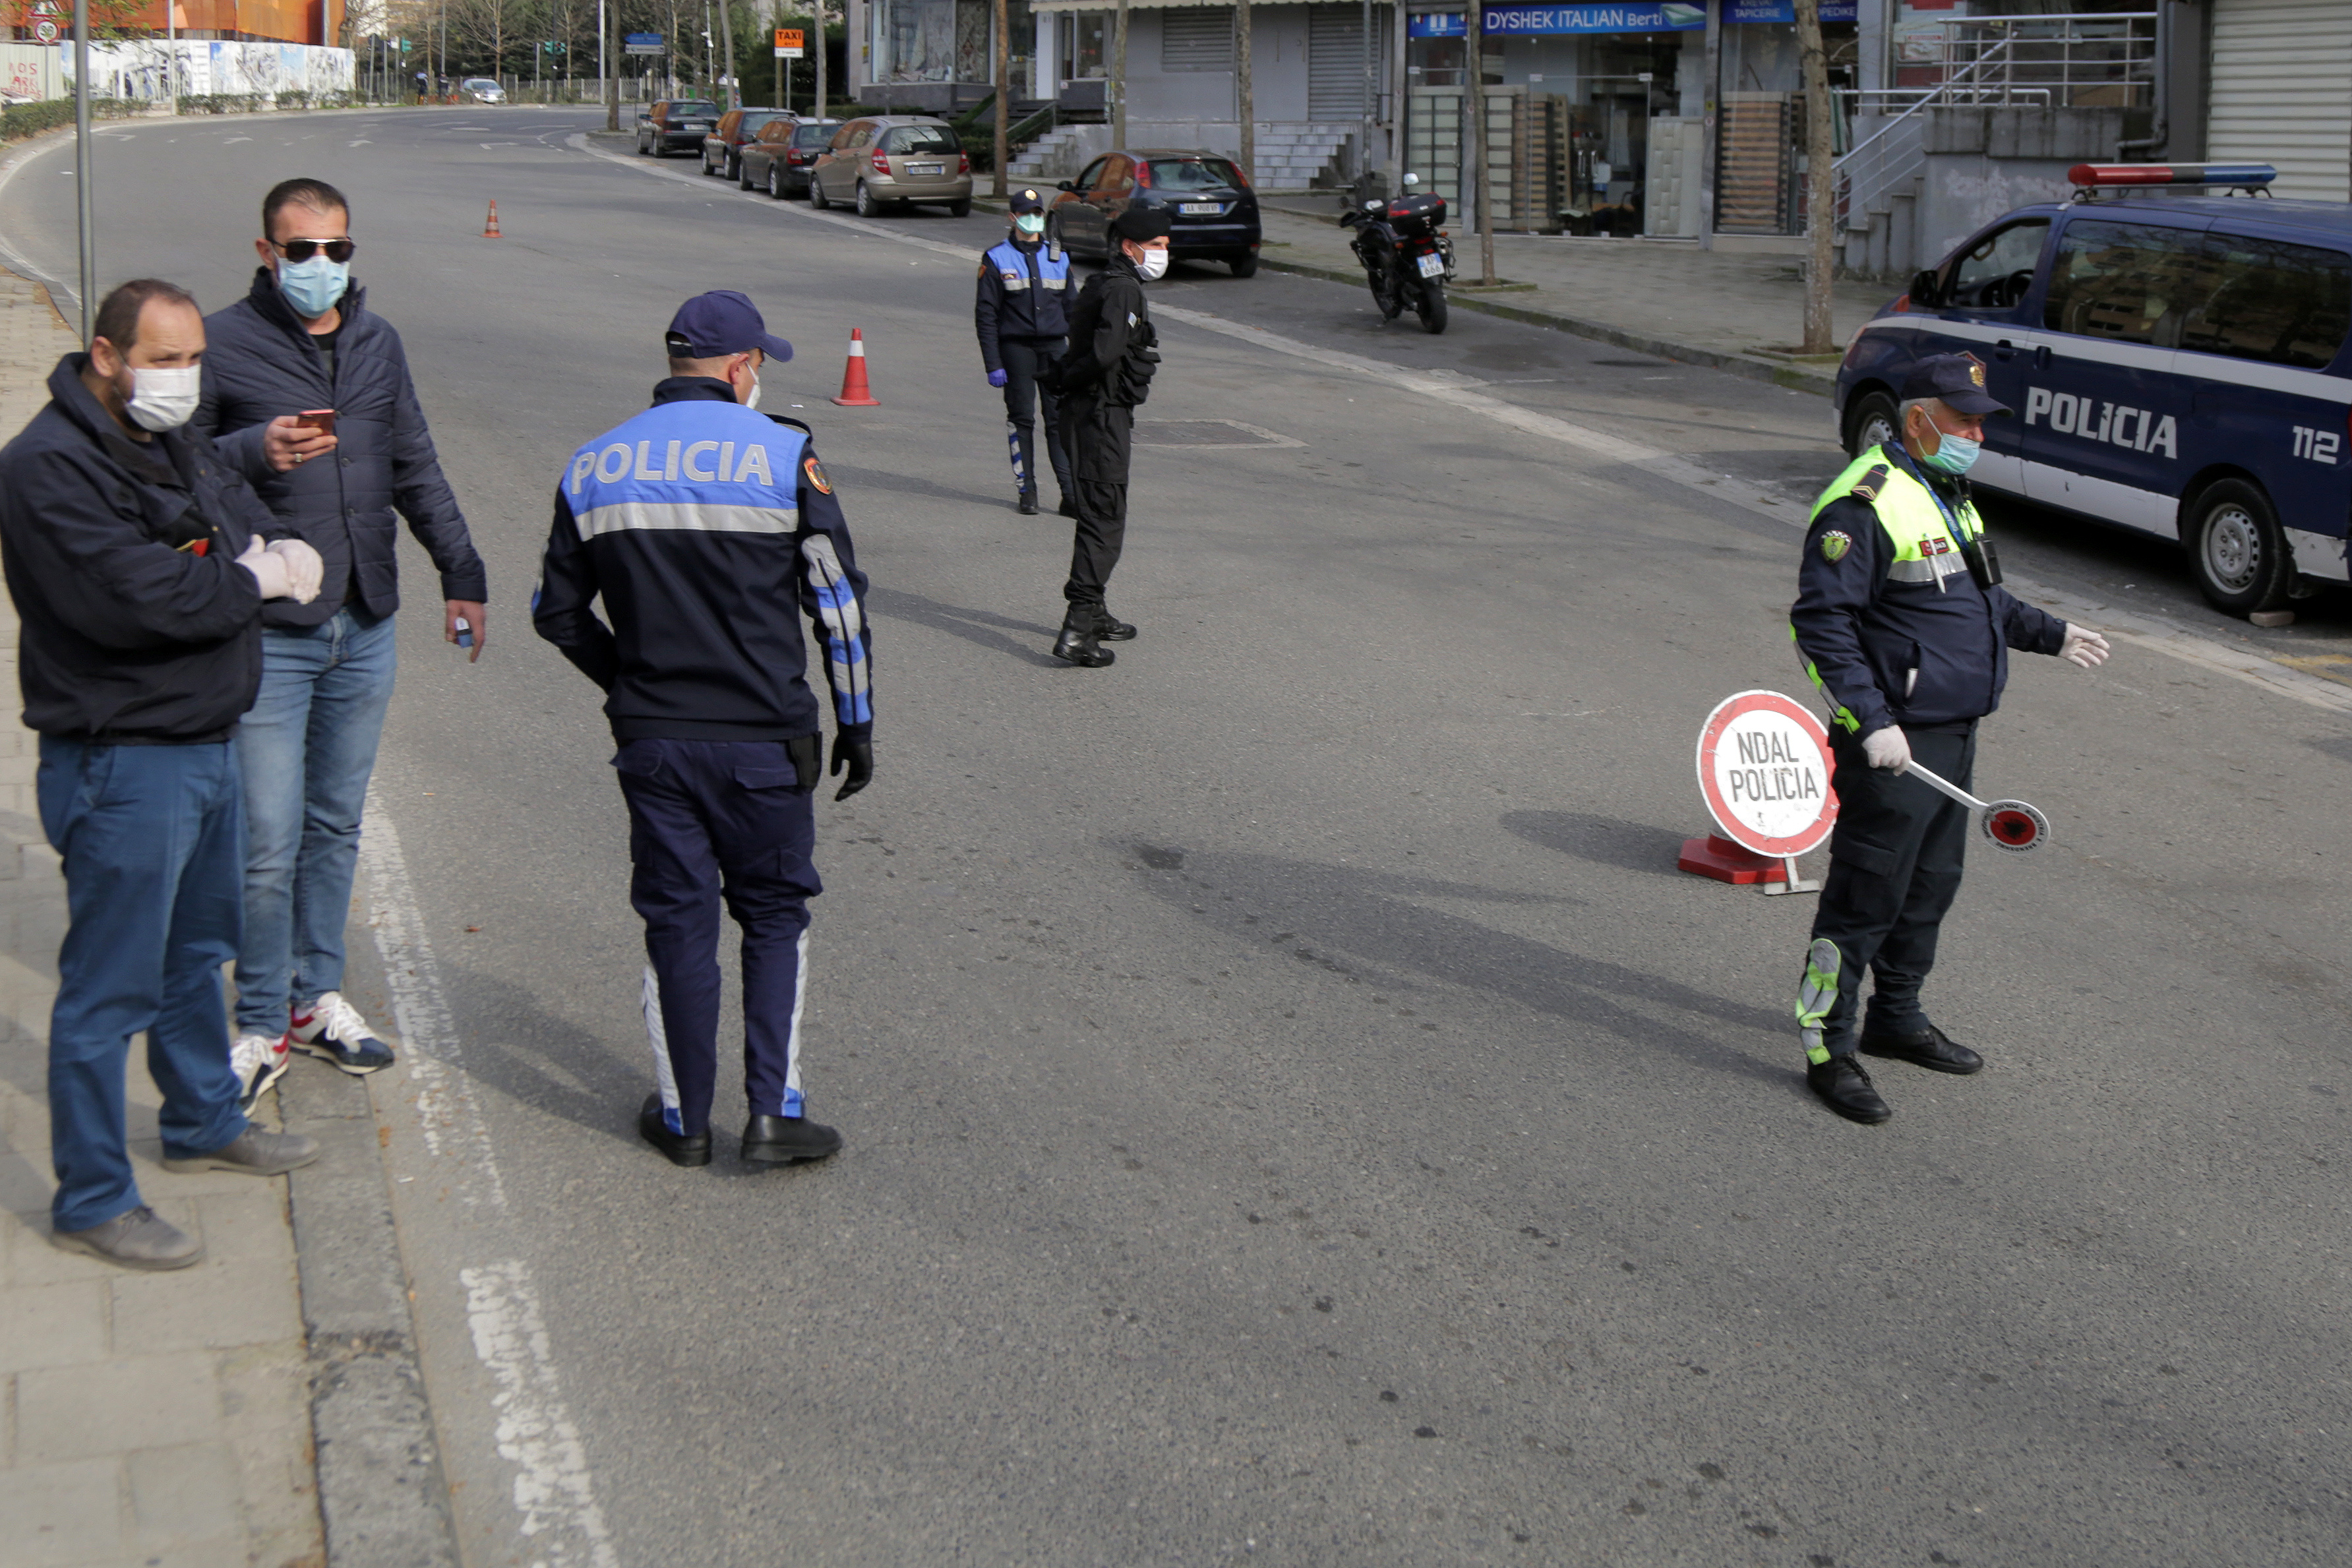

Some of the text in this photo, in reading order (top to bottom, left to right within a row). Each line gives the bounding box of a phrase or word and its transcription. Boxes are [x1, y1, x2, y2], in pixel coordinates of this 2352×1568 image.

[777, 31, 802, 40] TAXI
[1486, 9, 1663, 30] DYSHEK ITALIAN Berti
[2025, 386, 2177, 460] POLICIA
[2293, 425, 2340, 465] 112
[571, 440, 773, 495] POLICIA
[1736, 731, 1799, 764] NDAL
[1729, 767, 1819, 802] POLICIA
